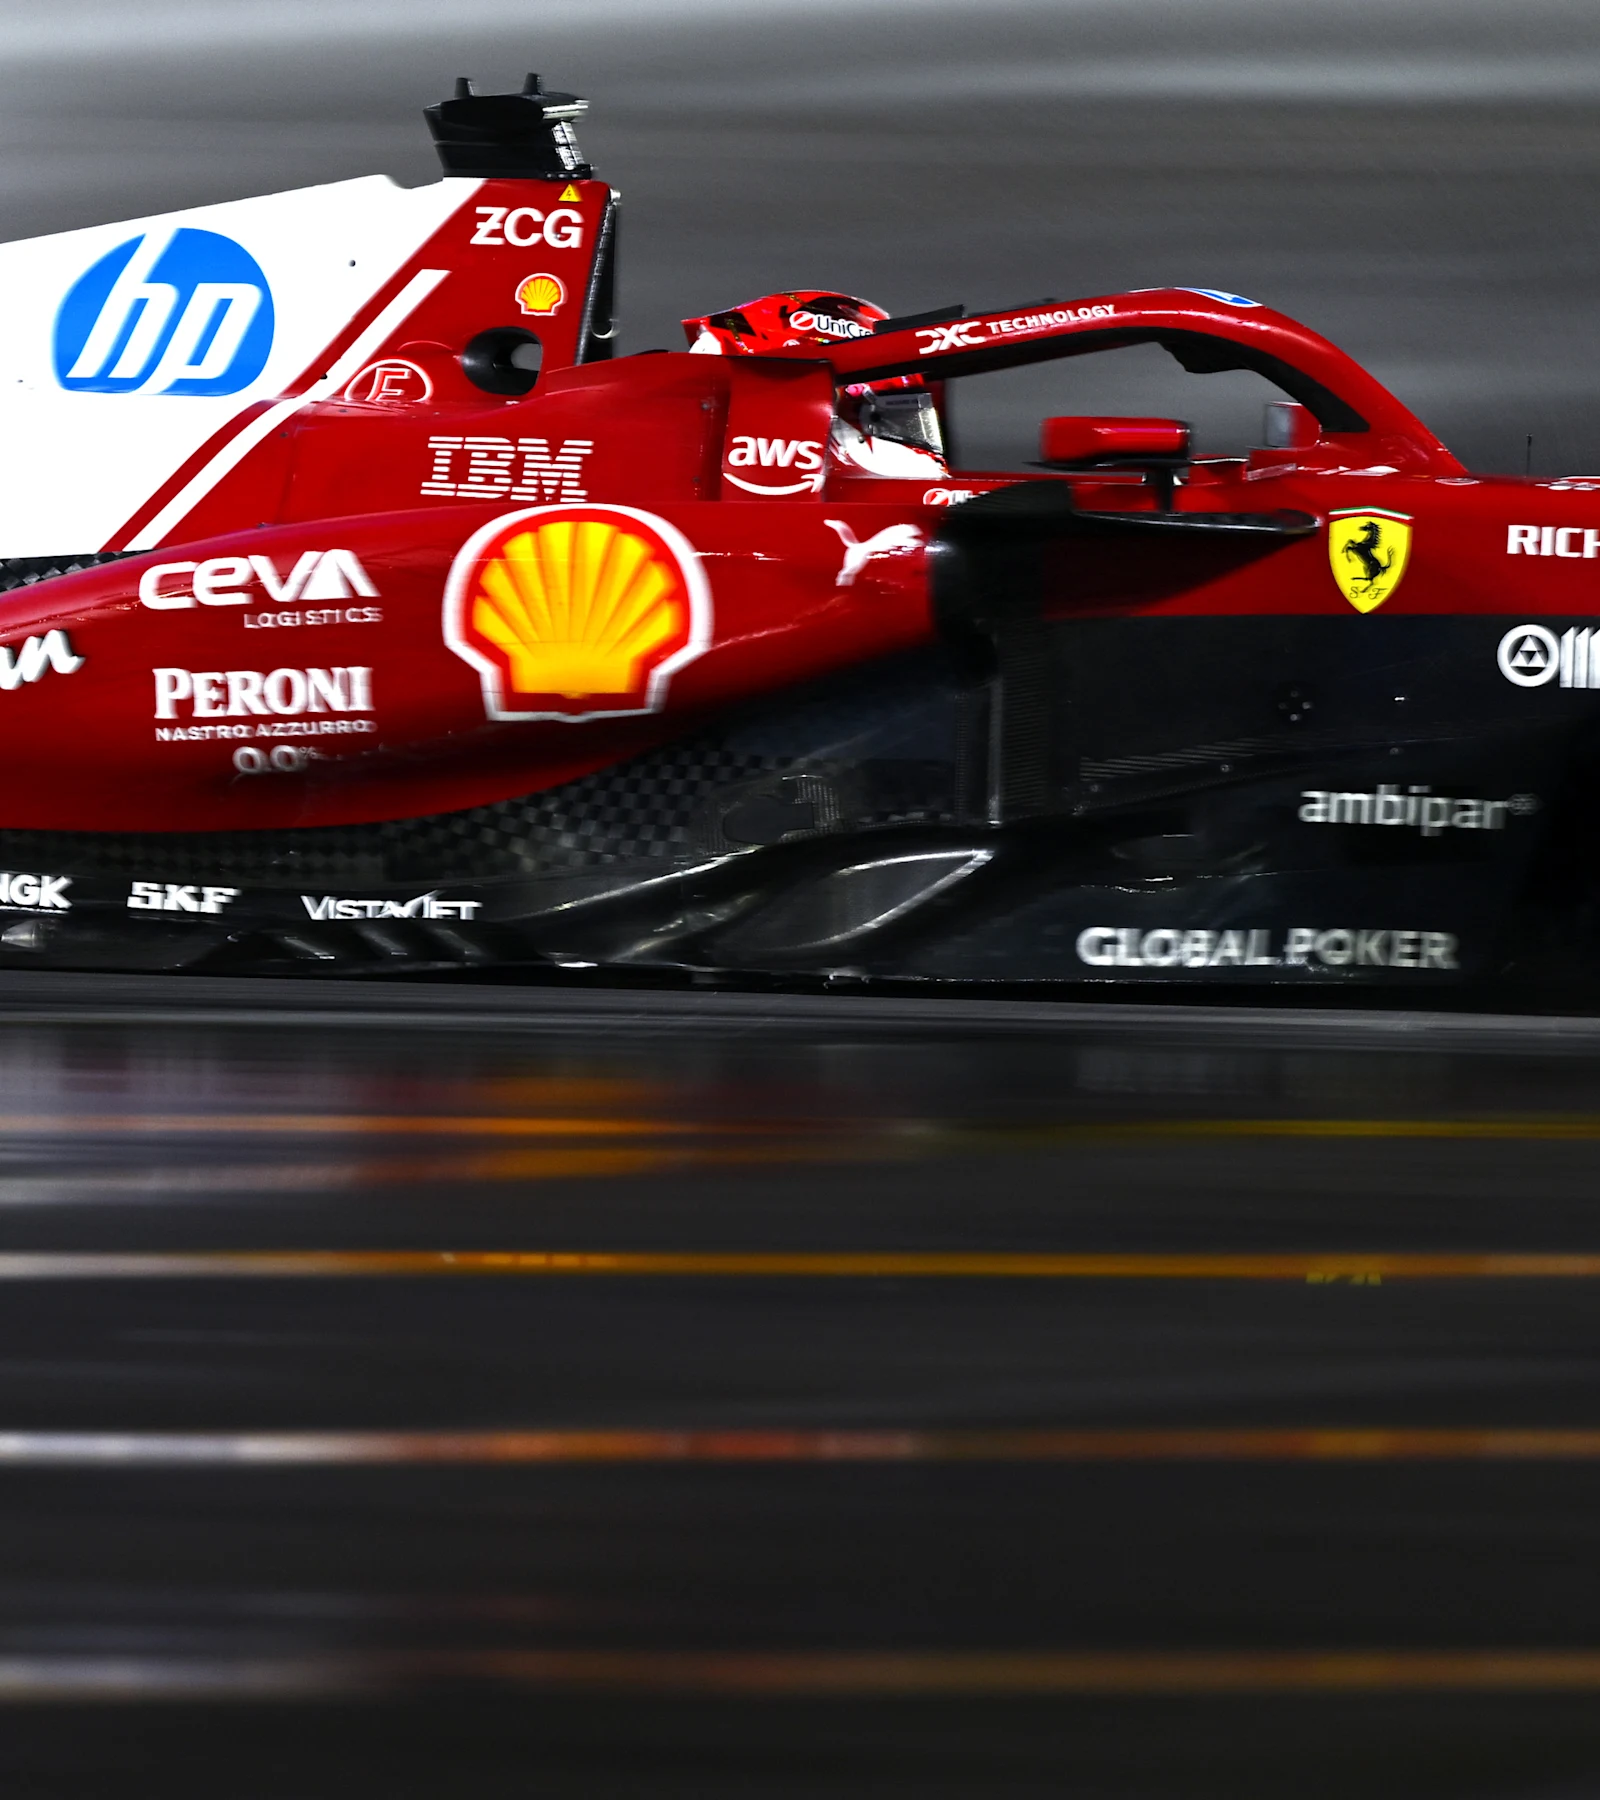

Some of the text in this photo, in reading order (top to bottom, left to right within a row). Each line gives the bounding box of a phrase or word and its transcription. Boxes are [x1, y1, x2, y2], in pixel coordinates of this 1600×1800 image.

[64, 228, 263, 395] hp
[985, 304, 1117, 336] TECHNOLOGY
[420, 435, 594, 503] IBM
[728, 434, 824, 471] aws
[243, 606, 384, 630] LOGISTICS
[152, 666, 374, 720] PERONI
[155, 718, 378, 742] NASTRO AZZURRO
[127, 881, 242, 914] SKF
[1076, 926, 1459, 970] GLOBAL POKER
